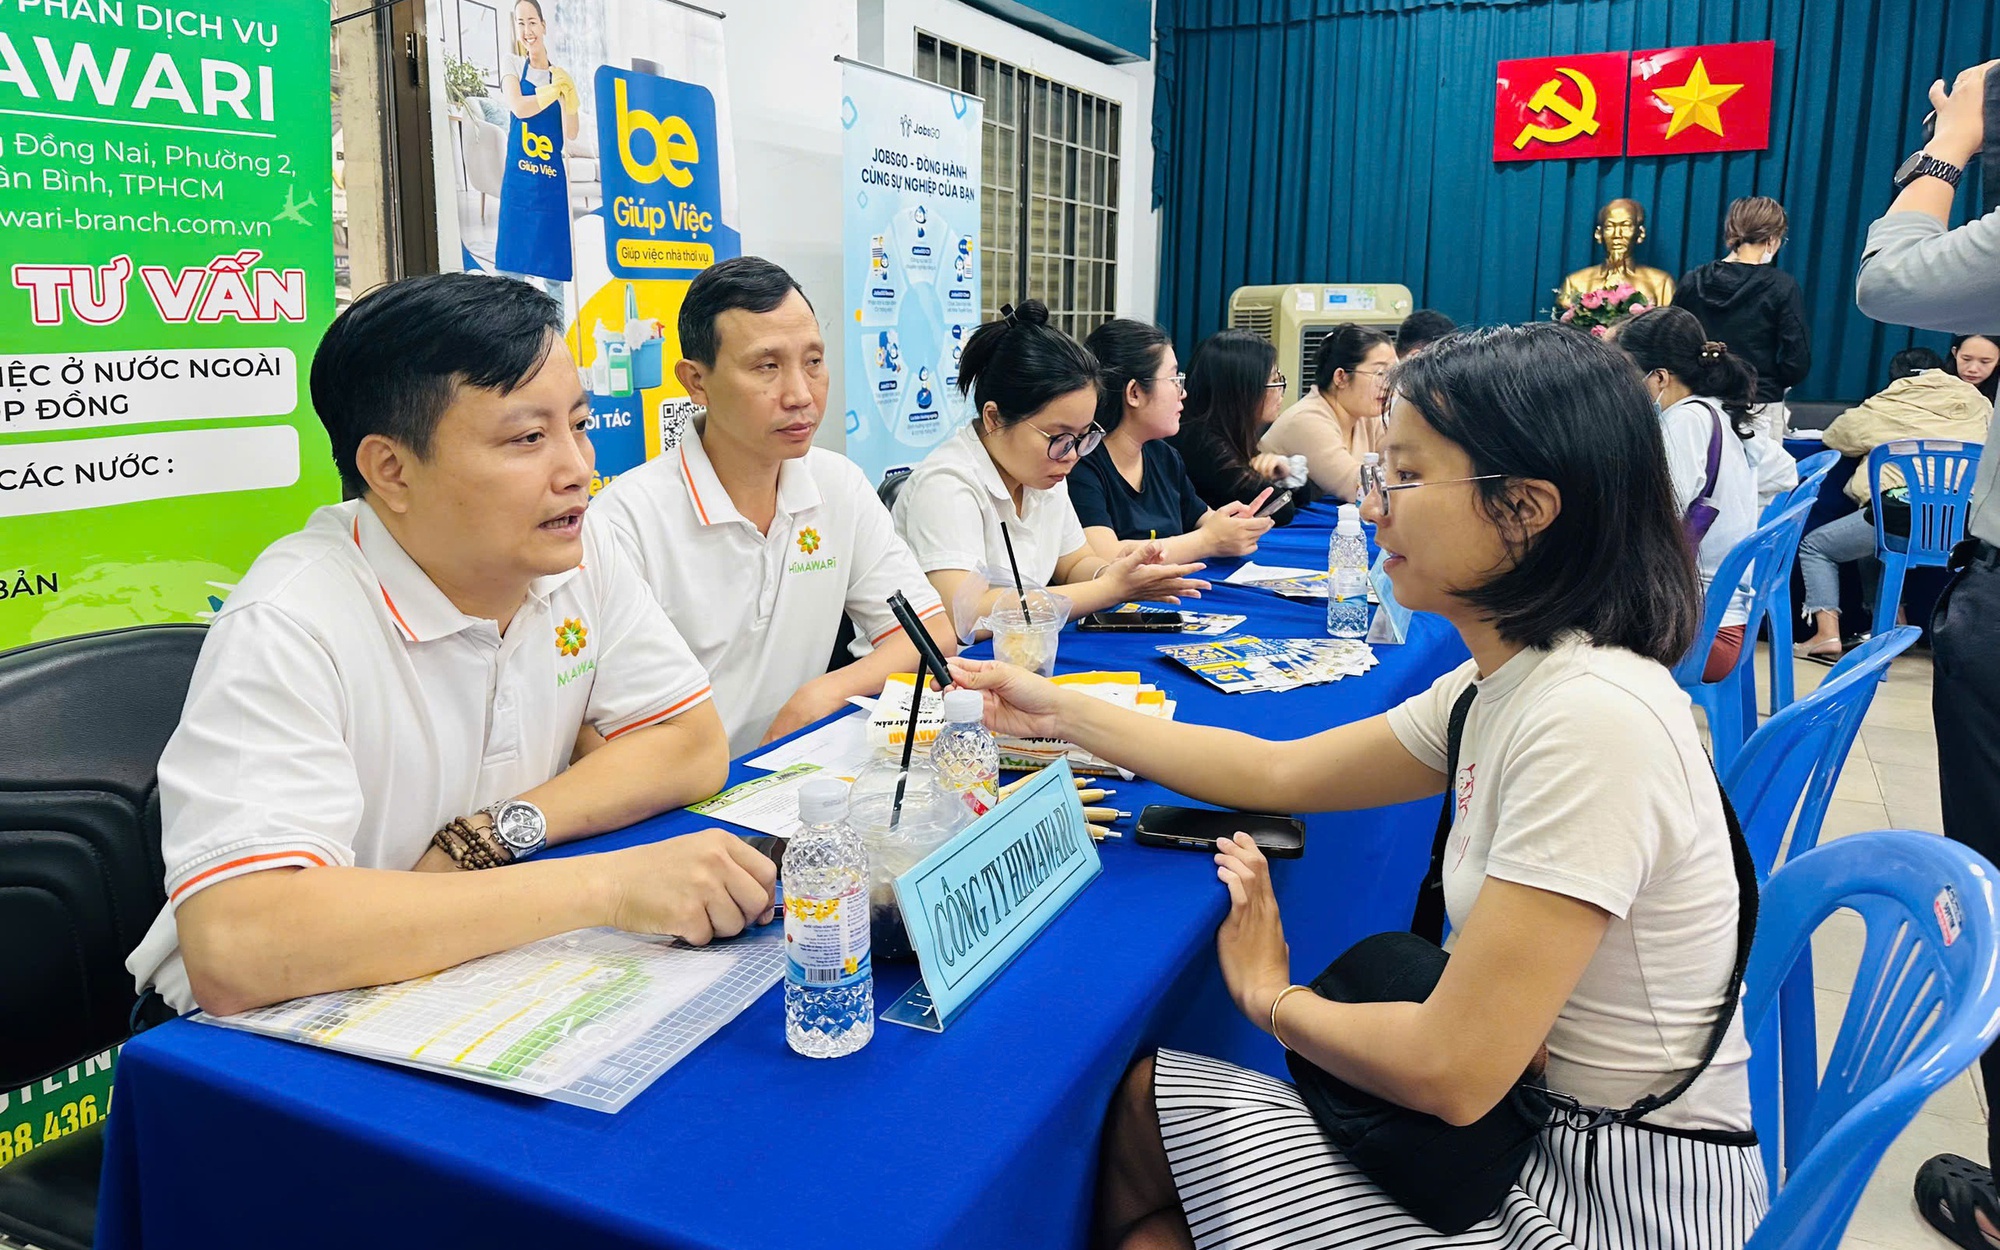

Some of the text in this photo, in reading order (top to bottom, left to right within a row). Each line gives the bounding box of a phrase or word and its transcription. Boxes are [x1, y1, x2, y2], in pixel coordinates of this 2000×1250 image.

[136, 5, 223, 39] DỊCH
[232, 18, 279, 53] VỤ
[521, 121, 554, 161] be
[614, 77, 700, 188] be
[913, 123, 941, 140] JobsGO
[13, 132, 297, 178] Đồng Nai, Phường 2,
[518, 159, 557, 178] Giúp Việc
[872, 147, 908, 168] JOBSGO
[916, 153, 941, 174] ĐỒNG
[942, 160, 968, 180] HÀNH
[42, 168, 114, 198] Bình,
[119, 173, 224, 200] TPHCM
[861, 165, 975, 203] CÙNG SỰ NGHIỆP CỦA BẠN
[613, 195, 713, 240] Giúp Việc
[621, 246, 709, 266] Giúp việc nhà thời vụ
[12, 249, 308, 326] TƯ VẤN
[61, 356, 85, 386] Ở
[95, 355, 180, 383] NƯỚC
[189, 353, 281, 379] NGOÀI
[35, 390, 129, 420] ĐỒNG
[585, 408, 631, 430] ỐI TÁC
[0, 462, 65, 490] CÁC
[75, 452, 160, 484] NƯỚC
[934, 876, 990, 967] CÔNG
[981, 853, 1011, 925] TY
[1002, 802, 1078, 908] HIMAWARI
